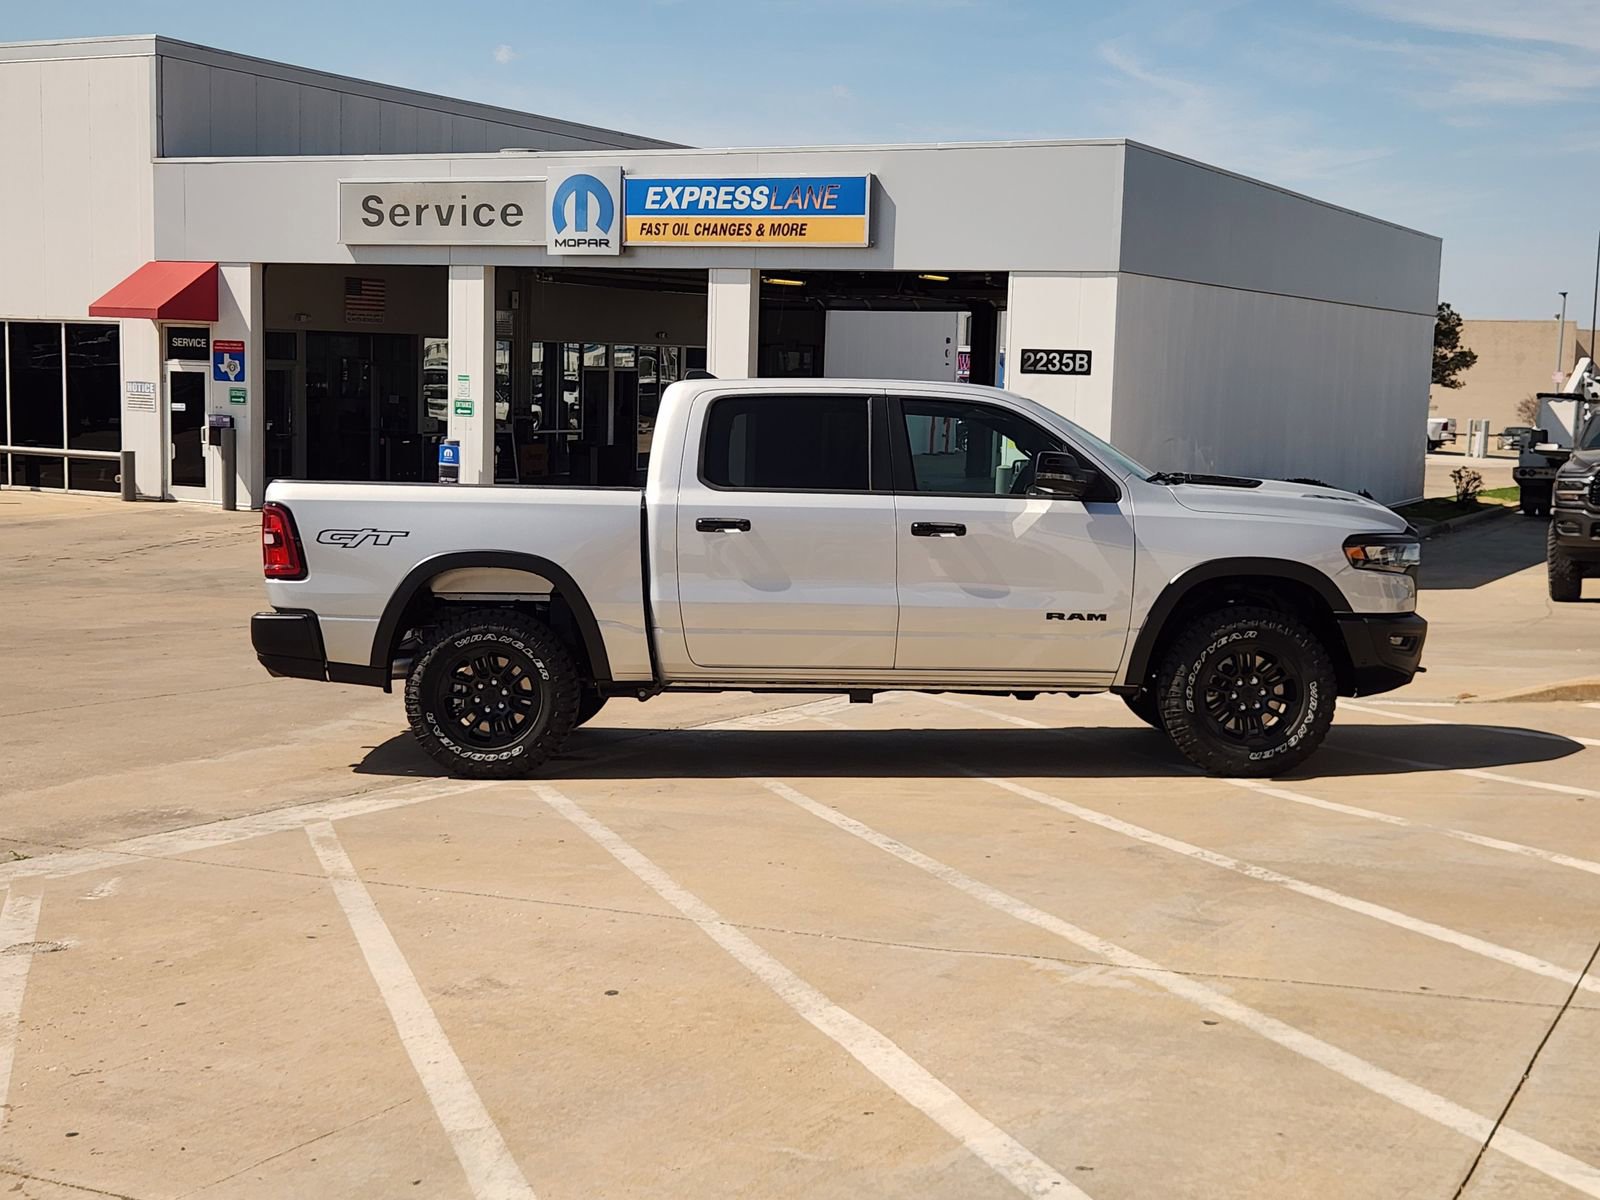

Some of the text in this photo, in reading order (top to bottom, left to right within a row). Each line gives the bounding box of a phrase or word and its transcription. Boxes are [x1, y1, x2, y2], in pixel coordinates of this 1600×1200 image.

[361, 195, 524, 227] Service
[640, 223, 808, 236] FAST OIL CHANGES & MORE
[555, 238, 611, 248] MOPAR
[171, 337, 207, 348] SERVICE
[1023, 352, 1089, 372] 2235B
[127, 382, 155, 392] NOTICE
[1046, 612, 1107, 621] RAM
[455, 633, 550, 681] WRANGLER
[1186, 630, 1258, 713] GOODYEAR
[1249, 681, 1318, 760] WRANGLER
[426, 711, 524, 761] GOODYEAR
